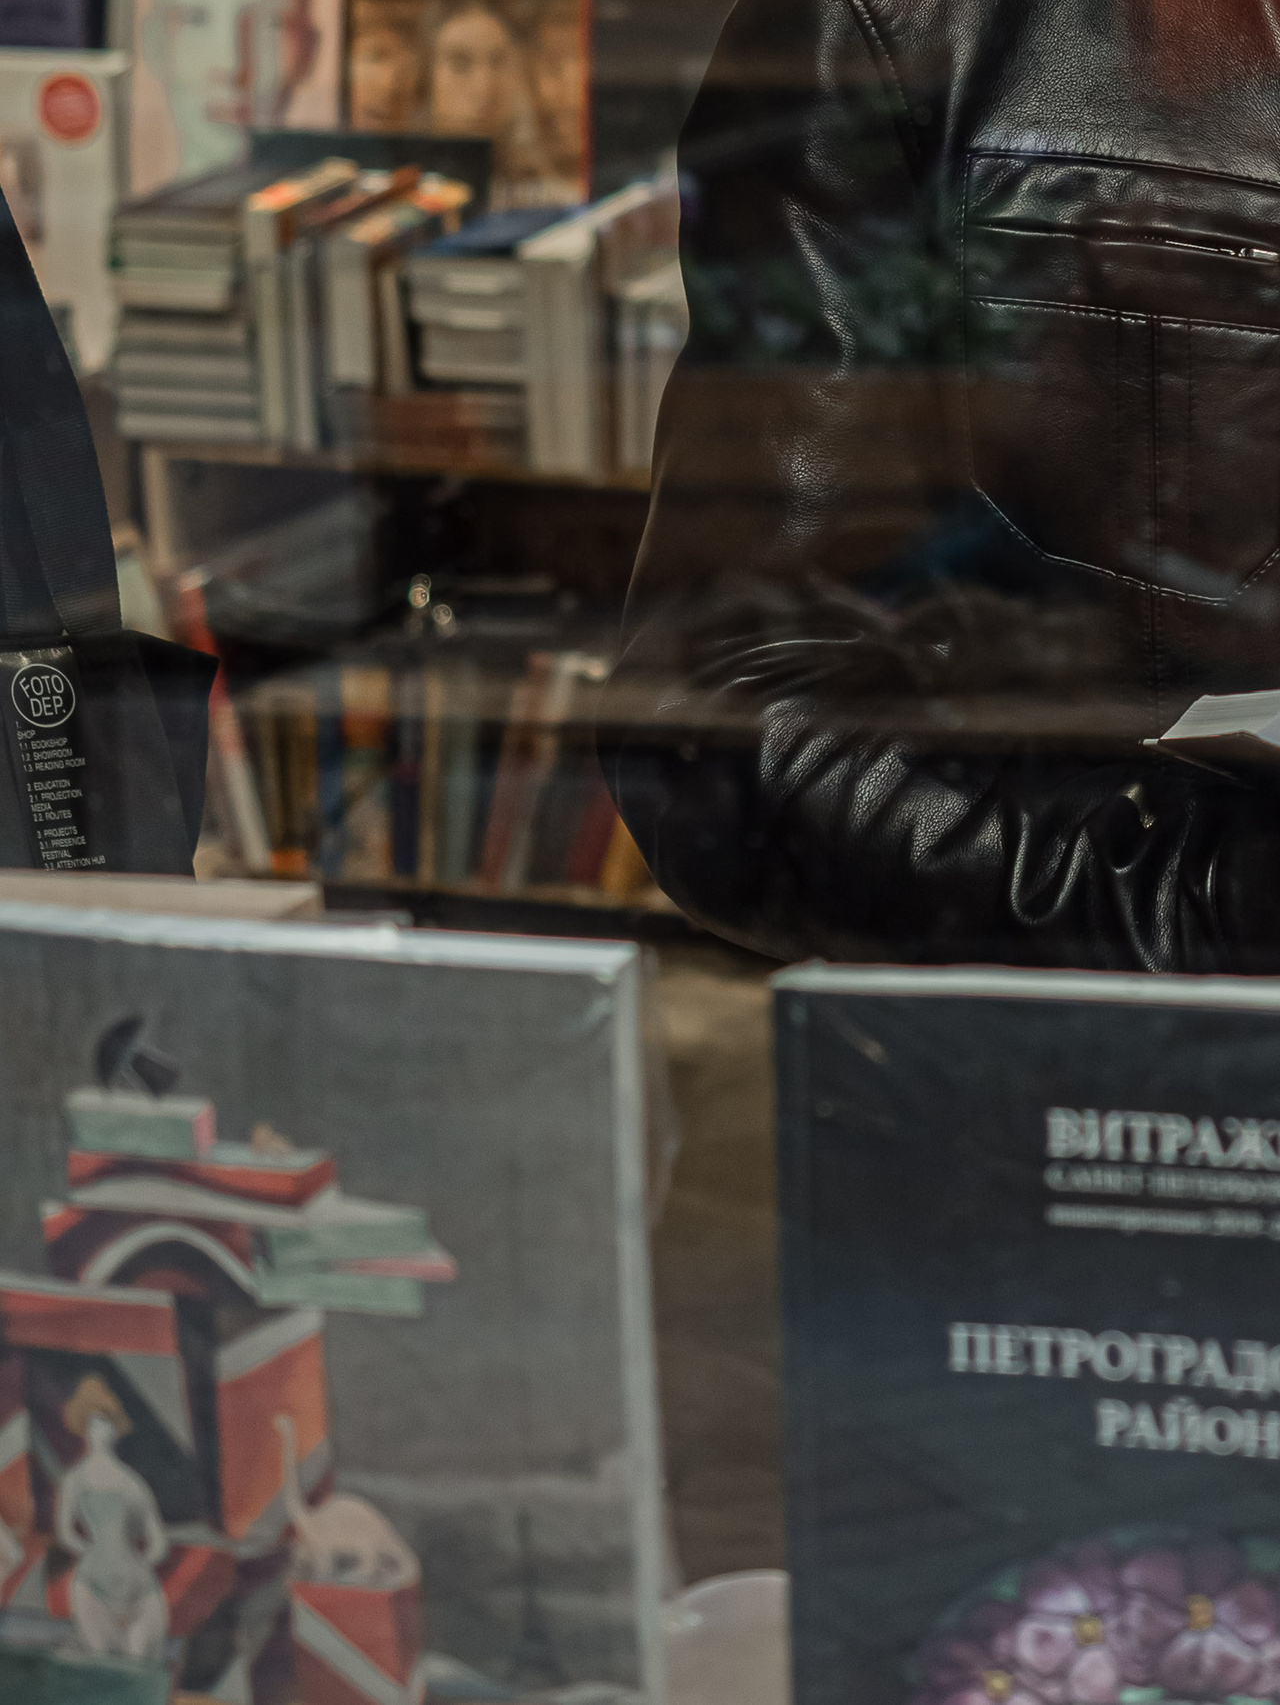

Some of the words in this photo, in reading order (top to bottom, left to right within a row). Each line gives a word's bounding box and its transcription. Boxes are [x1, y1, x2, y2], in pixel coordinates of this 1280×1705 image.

[19, 674, 64, 699] FOTO
[30, 695, 66, 717] DEP.
[16, 729, 36, 740] SHOP
[30, 737, 68, 750] BOOKSHOP
[32, 748, 73, 761] SHOWROOM
[35, 760, 65, 771] READING
[65, 757, 86, 768] ROOM
[33, 778, 71, 791] EDUCATION
[40, 788, 83, 802] PROJECTION
[30, 802, 53, 813] MEDIA
[44, 809, 73, 821] ROUTES
[43, 825, 78, 838] PROJECTS
[51, 835, 87, 848] PRESENCE
[41, 849, 72, 861] FESTIVAL
[56, 857, 92, 869] ATTENTION
[91, 854, 106, 865] HUB
